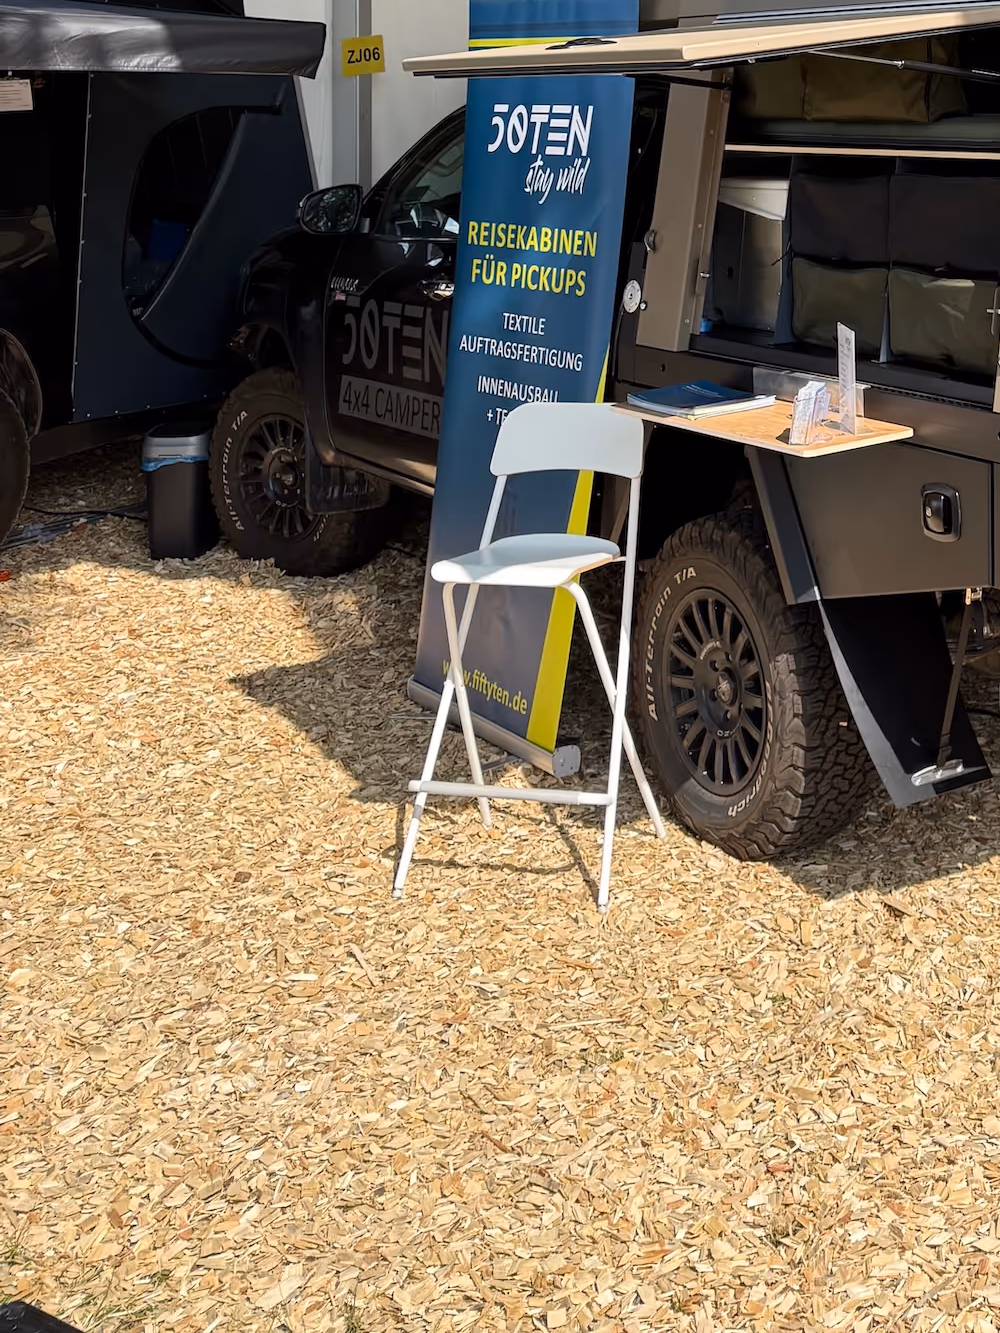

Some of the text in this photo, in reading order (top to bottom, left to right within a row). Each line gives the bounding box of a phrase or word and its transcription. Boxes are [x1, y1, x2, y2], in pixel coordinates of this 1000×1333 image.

[347, 47, 381, 64] ZJ06
[487, 104, 594, 156] 50TEN
[524, 154, 591, 204] stay wild
[467, 221, 597, 257] REISEKABINEN
[471, 254, 586, 297] FÜR PICKUPS
[503, 313, 546, 335] TEXTILE
[459, 334, 583, 371] AUFTRAGSFERTIGUNG
[342, 381, 370, 413] 4x4
[477, 375, 559, 403] INNENAUSBAU
[231, 410, 248, 431] T/A
[674, 566, 697, 584] T/A
[443, 660, 527, 714] ww.fiftyten.de
